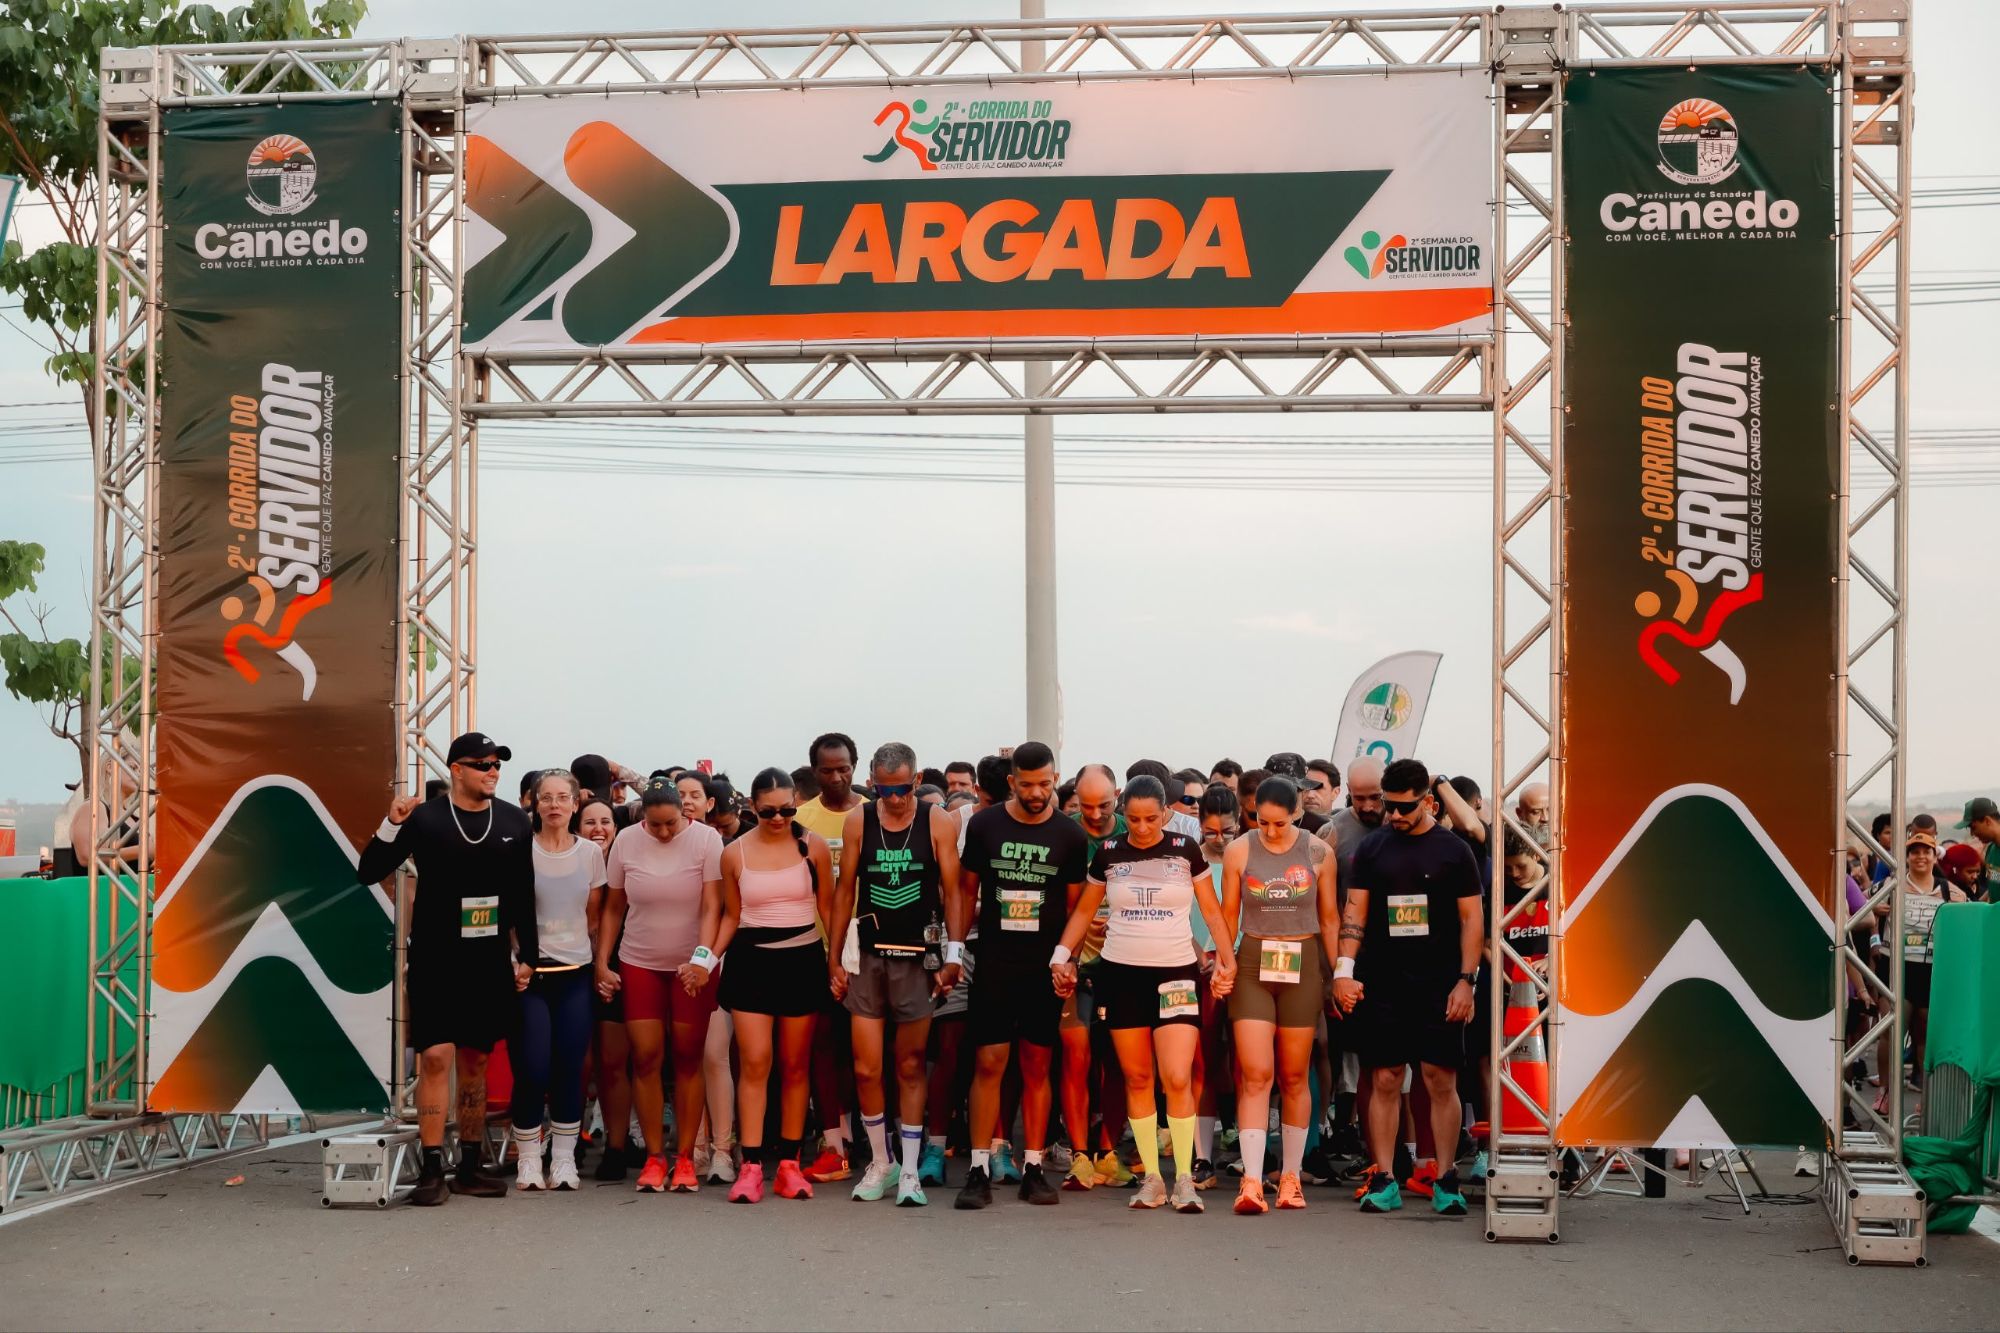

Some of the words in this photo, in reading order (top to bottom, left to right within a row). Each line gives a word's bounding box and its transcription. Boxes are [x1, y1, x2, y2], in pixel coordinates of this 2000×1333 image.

[968, 101, 1028, 120] CORRIDA
[1032, 99, 1052, 119] DO
[928, 120, 1071, 163] SERVIDOR
[940, 162, 964, 170] GENTE
[965, 162, 981, 170] QUE
[981, 161, 996, 169] FAZ
[996, 161, 1027, 169] CANEDO
[1027, 161, 1064, 170] AVANÇAR
[1636, 192, 1690, 200] Prefeitura
[1694, 191, 1706, 199] de
[1709, 190, 1752, 198] Senador
[1600, 190, 1800, 232] Canedo
[227, 222, 274, 230] Prefeitura
[290, 220, 328, 228] Senador
[1605, 234, 1631, 242] COM
[1636, 231, 1672, 242] VOCÊ,
[1676, 231, 1724, 241] MELHOR
[1728, 231, 1735, 239] A
[1740, 231, 1772, 240] CADA
[1776, 230, 1797, 239] DIA
[194, 219, 368, 260] Canedo
[770, 197, 1252, 286] LARGADA
[1420, 237, 1457, 245] SEMANA
[1459, 236, 1473, 244] DO
[200, 262, 222, 270] COM
[226, 259, 257, 269] VOCÊ,
[261, 259, 302, 267] MELHOR
[306, 258, 312, 266] A
[316, 257, 344, 265] CADA
[348, 256, 365, 264] DIA
[1385, 245, 1480, 272] SERVIDOR
[1641, 376, 1674, 412] DO
[1750, 355, 1765, 416] AVANÇAR
[230, 394, 258, 428] DO
[323, 374, 336, 431] AVANÇAR
[1750, 418, 1762, 471] CANEDO
[323, 434, 333, 482] CANEDO
[1641, 415, 1674, 521] CORRIDA
[1676, 342, 1750, 591] SERVIDOR
[228, 431, 257, 530] CORRIDA
[258, 362, 322, 595] SERVIDOR
[1750, 473, 1762, 496] FAZ
[323, 484, 333, 506] FAZ
[323, 508, 333, 533] QUE
[1751, 497, 1763, 525] QUE
[322, 534, 332, 573] GENTE
[1750, 526, 1762, 568] GENTE
[876, 848, 913, 862] BORA
[1001, 841, 1051, 863] CITY
[880, 861, 909, 873] CITY
[998, 870, 1047, 884] RUNNERS
[1268, 889, 1289, 899] RX
[471, 910, 490, 925] 011
[1008, 903, 1032, 918] 023
[1120, 908, 1174, 918] TERRITÓRIO
[1395, 907, 1420, 924] 044
